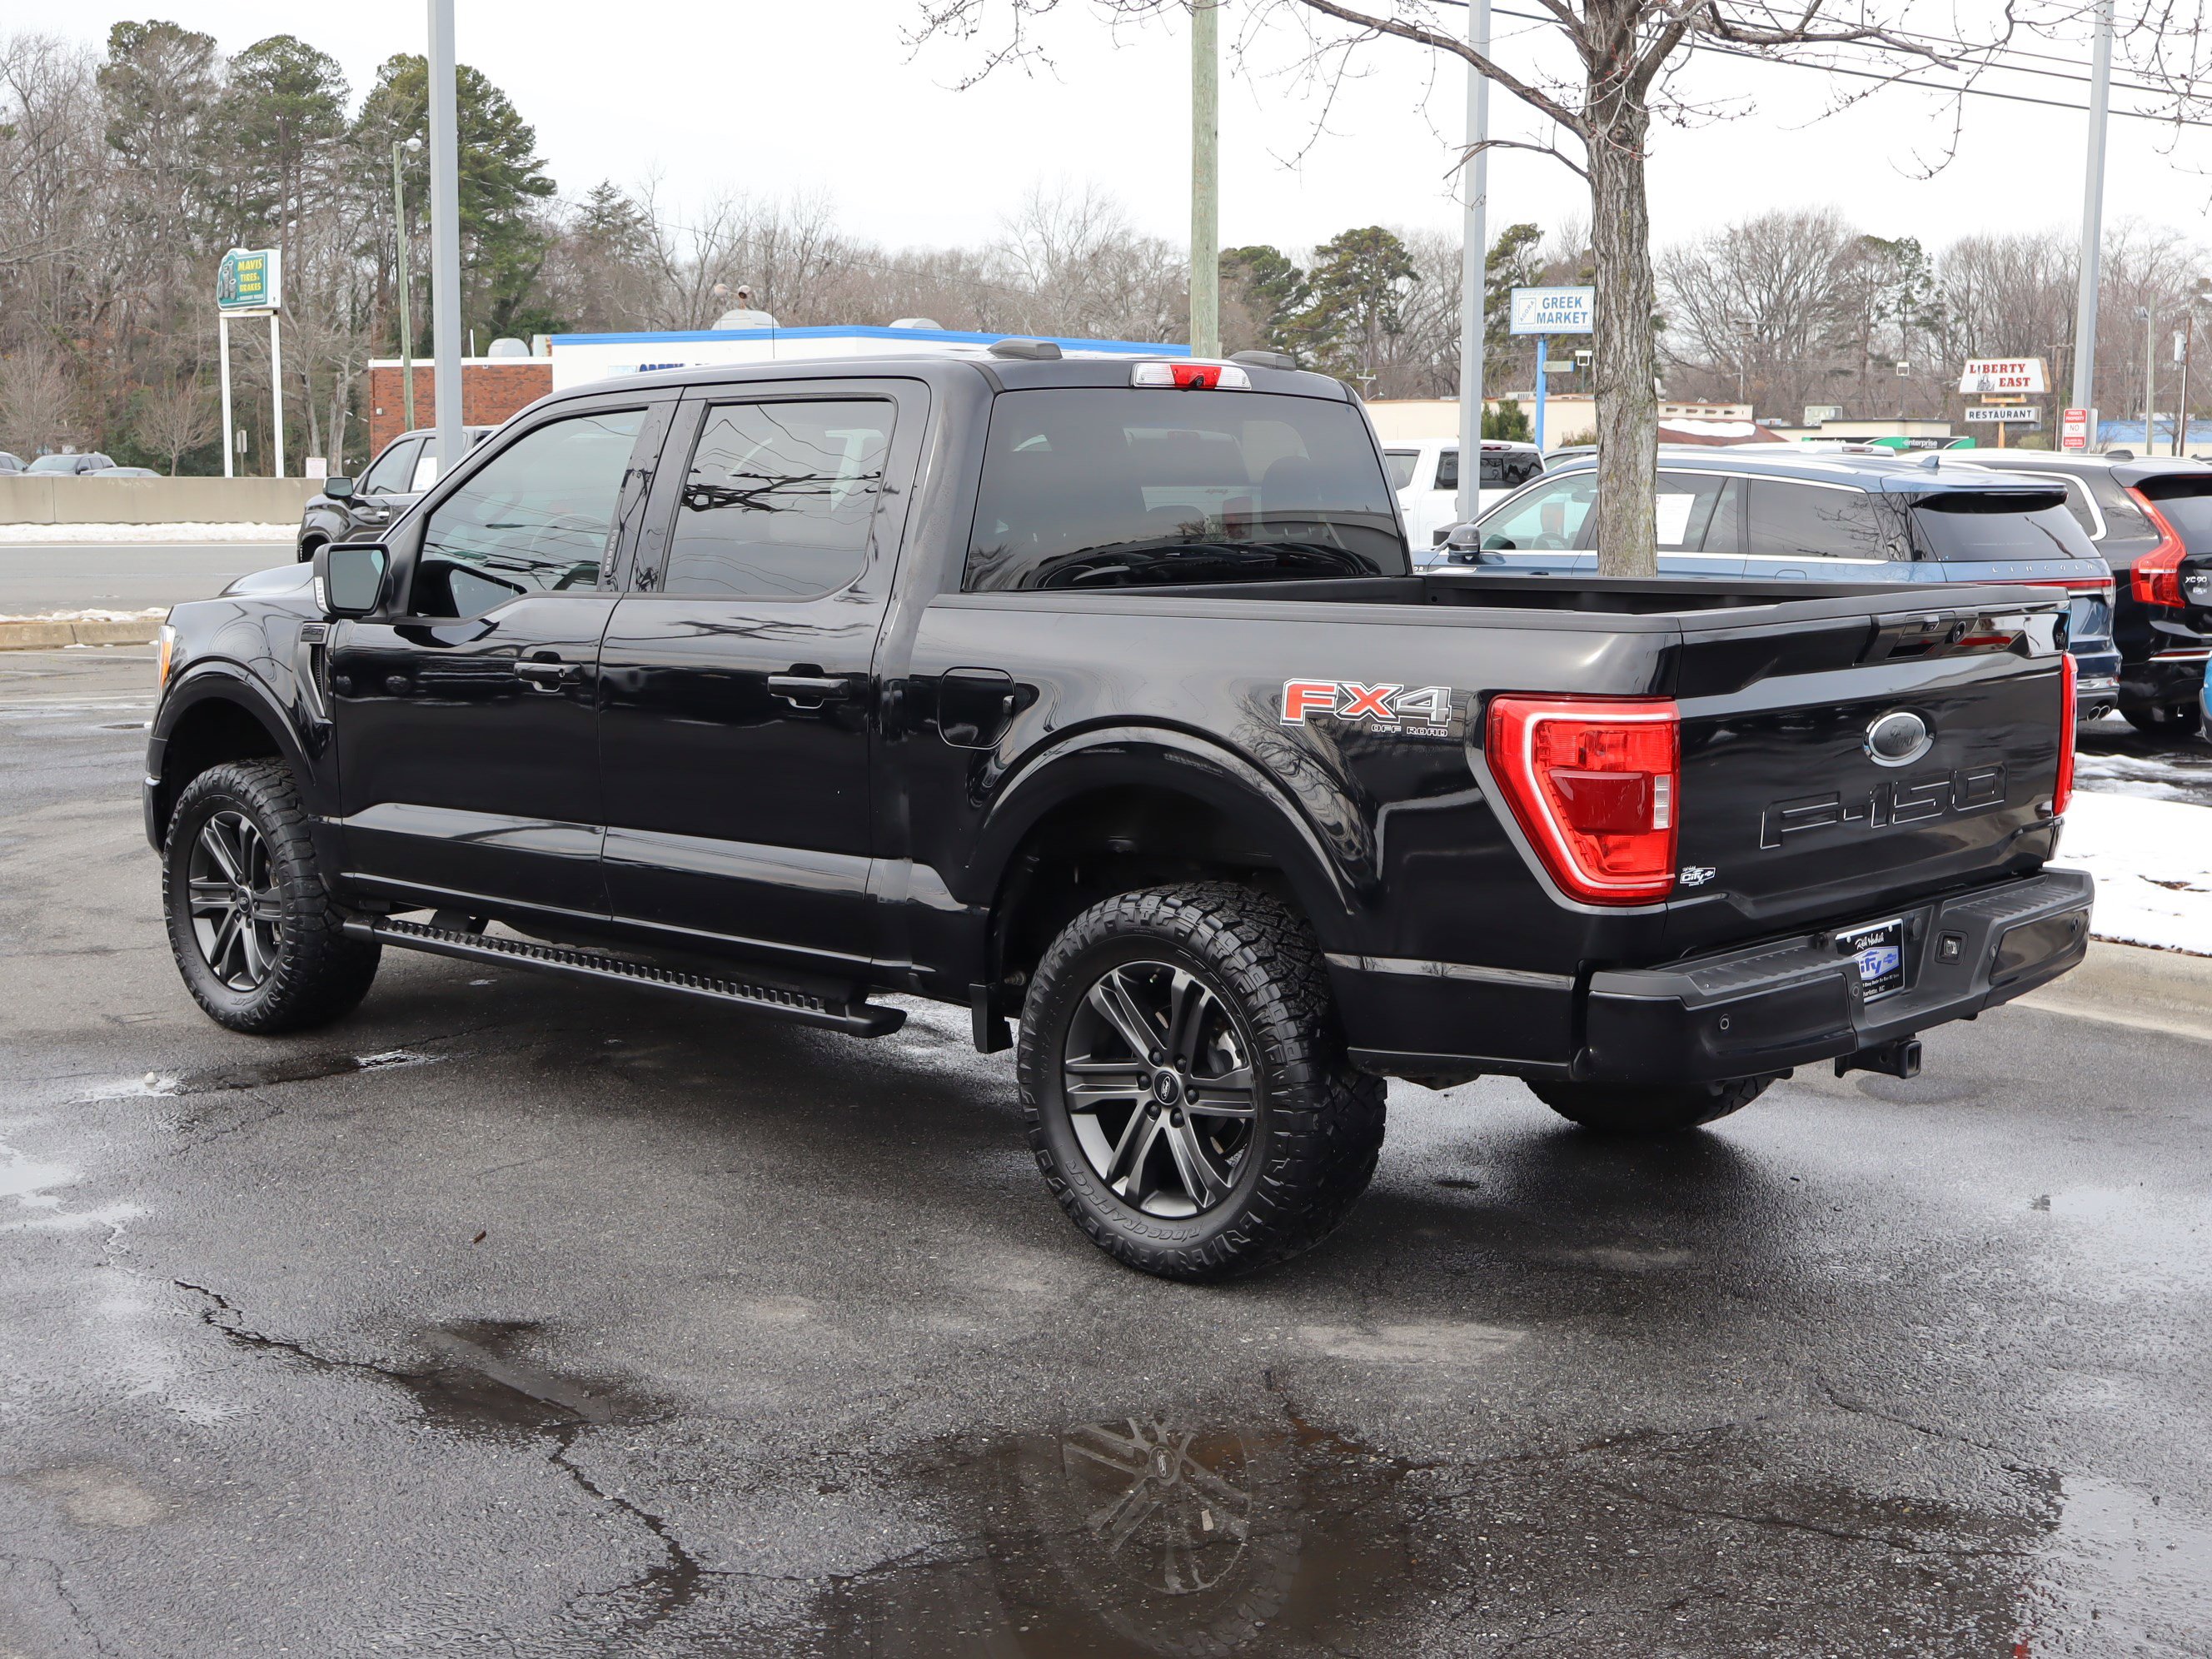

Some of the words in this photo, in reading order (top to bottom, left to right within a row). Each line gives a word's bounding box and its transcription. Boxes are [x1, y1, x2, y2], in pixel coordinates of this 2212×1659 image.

[237, 258, 262, 272] MAVIS
[240, 272, 257, 281] TIRES
[239, 282, 262, 292] BRAKES
[1542, 296, 1583, 310] GREEK
[1519, 300, 1535, 322] AGORA
[1537, 311, 1589, 324] MARKET
[1969, 363, 2026, 374] LIBERTY
[1999, 377, 2031, 387] EAST
[1969, 410, 2032, 419] RESTAURANT
[1902, 438, 1938, 448] enterprise
[1992, 564, 2094, 573] LINCOLN
[1280, 678, 1452, 726] FX4
[1371, 724, 1402, 734] OFF
[1406, 725, 1448, 737] ROAD
[1760, 761, 2008, 849] F-150
[1860, 957, 1882, 974] ity
